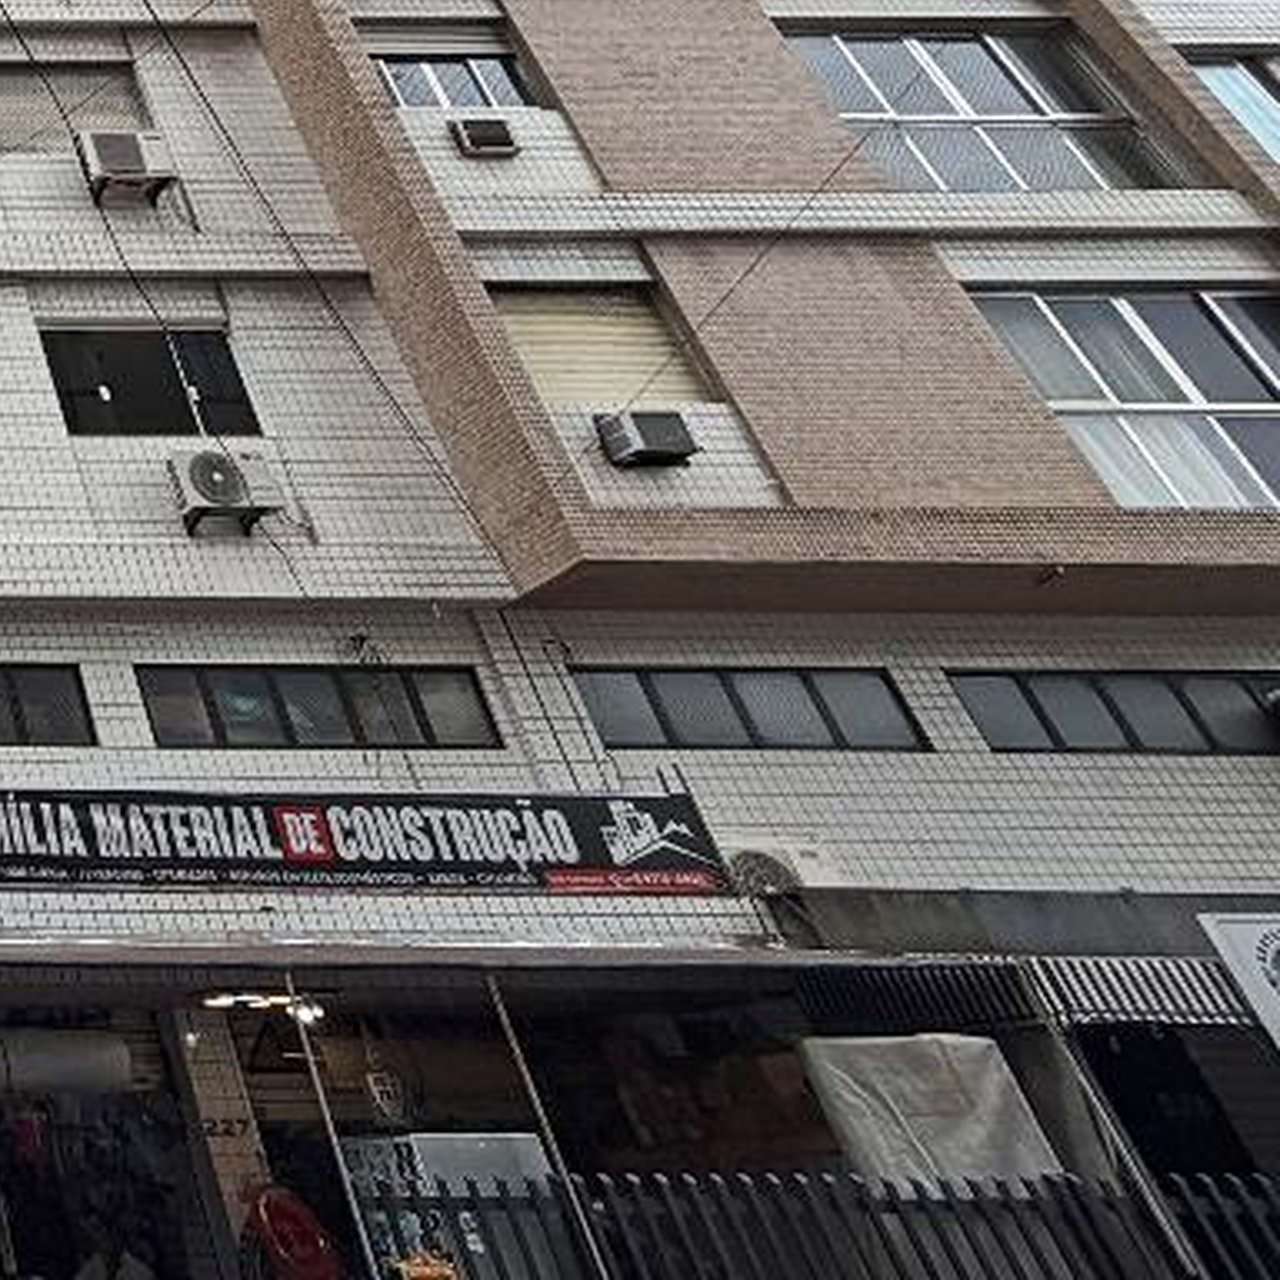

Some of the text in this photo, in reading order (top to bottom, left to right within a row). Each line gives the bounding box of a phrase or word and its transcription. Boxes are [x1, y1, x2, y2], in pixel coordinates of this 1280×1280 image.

[89, 800, 282, 859] MATERIAL
[282, 812, 327, 856] DE
[327, 798, 581, 871] CONSTRUÇÃO
